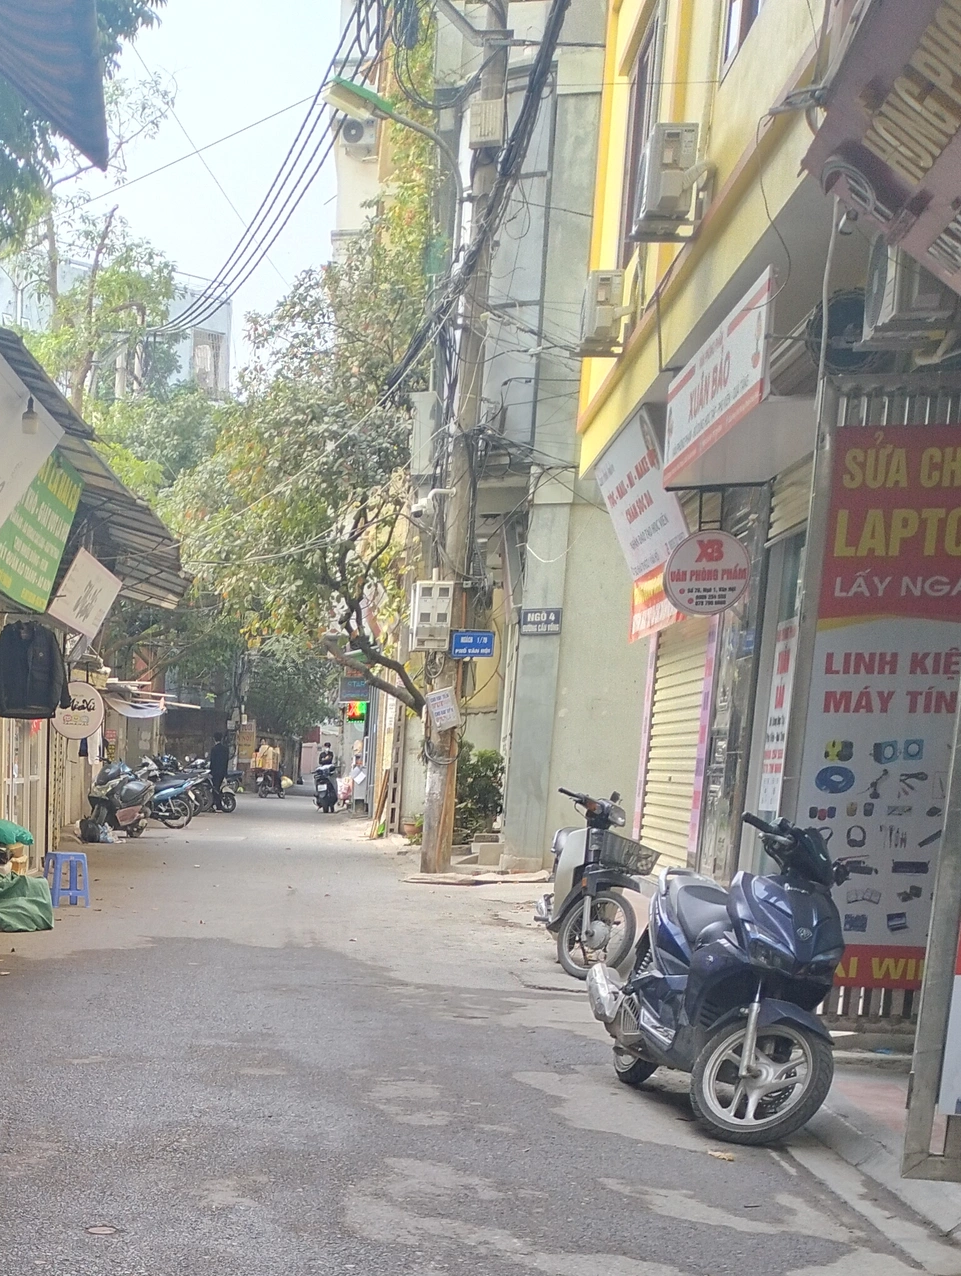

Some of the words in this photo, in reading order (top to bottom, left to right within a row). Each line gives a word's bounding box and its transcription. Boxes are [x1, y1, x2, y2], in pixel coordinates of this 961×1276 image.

[843, 431, 908, 489] SỬA
[695, 539, 724, 563] XB
[671, 569, 687, 582] VĂN
[690, 567, 718, 581] PHÒNG
[834, 569, 891, 597] LẤY
[549, 611, 555, 621] 4
[824, 652, 898, 675] LINH
[909, 647, 960, 680] KIỆ
[823, 685, 895, 713] MÁY
[905, 685, 957, 713] TÍN
